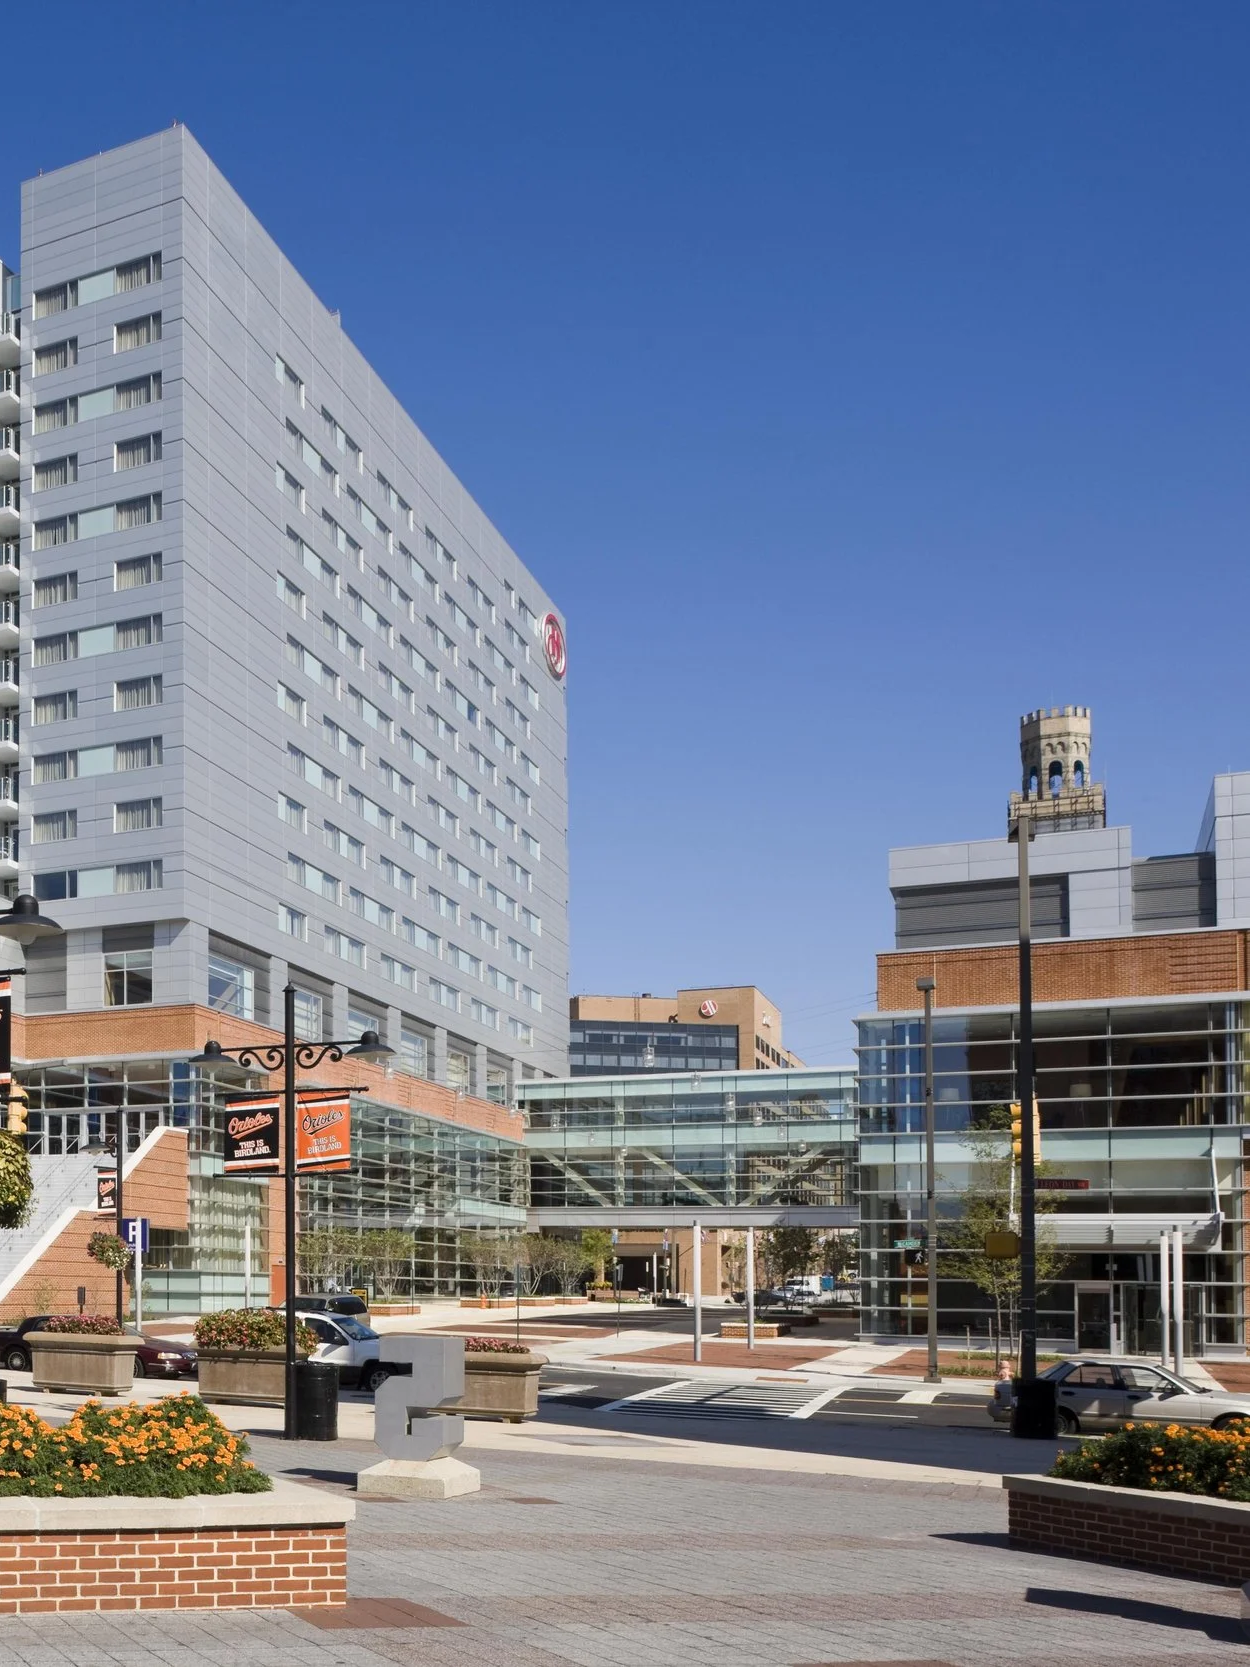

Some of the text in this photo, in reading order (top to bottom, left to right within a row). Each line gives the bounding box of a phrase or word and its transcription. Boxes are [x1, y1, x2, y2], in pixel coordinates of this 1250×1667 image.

[228, 1112, 273, 1135] Orioles
[302, 1108, 344, 1132] Orioles
[239, 1139, 264, 1149] THIS IS
[312, 1135, 337, 1145] THIS IS
